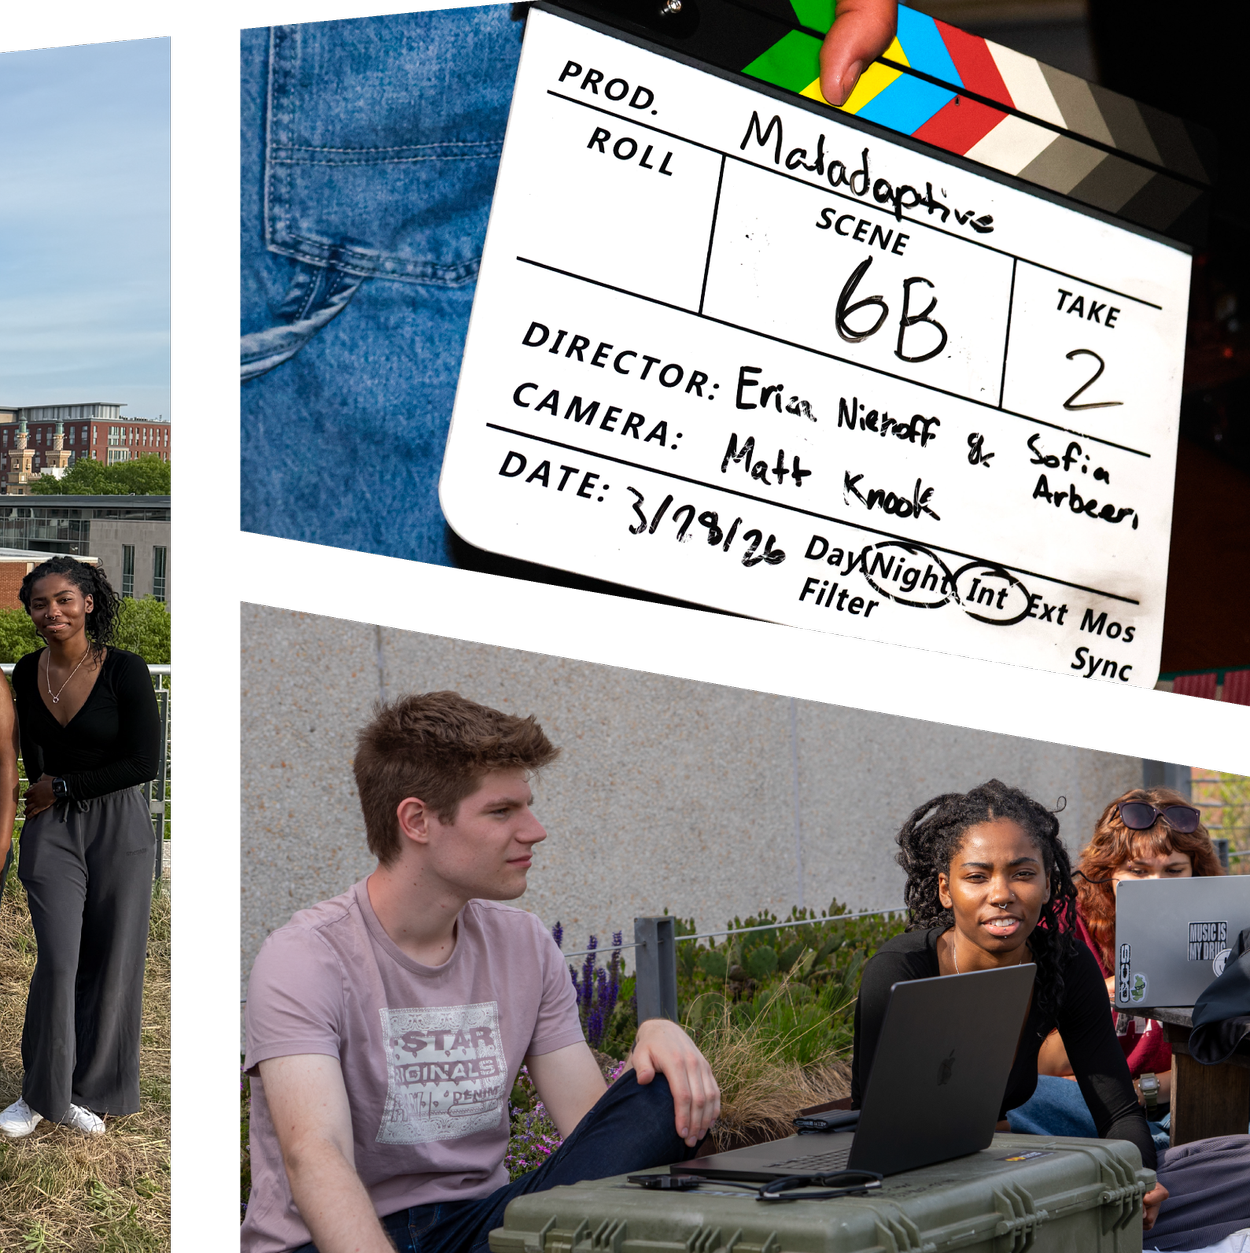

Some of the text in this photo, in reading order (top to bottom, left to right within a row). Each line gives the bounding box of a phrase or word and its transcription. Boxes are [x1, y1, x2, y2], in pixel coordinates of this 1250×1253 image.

[558, 60, 658, 115] PROD.
[586, 126, 673, 176] ROLL
[740, 110, 995, 233] Maladaptive
[815, 207, 910, 256] SCENE
[835, 255, 948, 363] 6B
[1055, 288, 1121, 329] TAKE
[521, 321, 720, 401] DIRECTOR:
[1063, 348, 1124, 412] 2
[512, 381, 683, 450] CAMERA:
[498, 450, 610, 503] DATE:
[720, 432, 812, 487] Matt
[967, 432, 996, 468] &
[1026, 432, 1110, 485] Sofia
[798, 576, 880, 619] Filter
[965, 577, 1009, 610] Int
[1027, 593, 1069, 626] Ext
[1080, 608, 1137, 643] Mos
[1070, 646, 1134, 682] Sync
[1190, 922, 1227, 942] MUSIC IS
[1190, 942, 1202, 961] MY
[452, 1085, 500, 1102] DENIM
